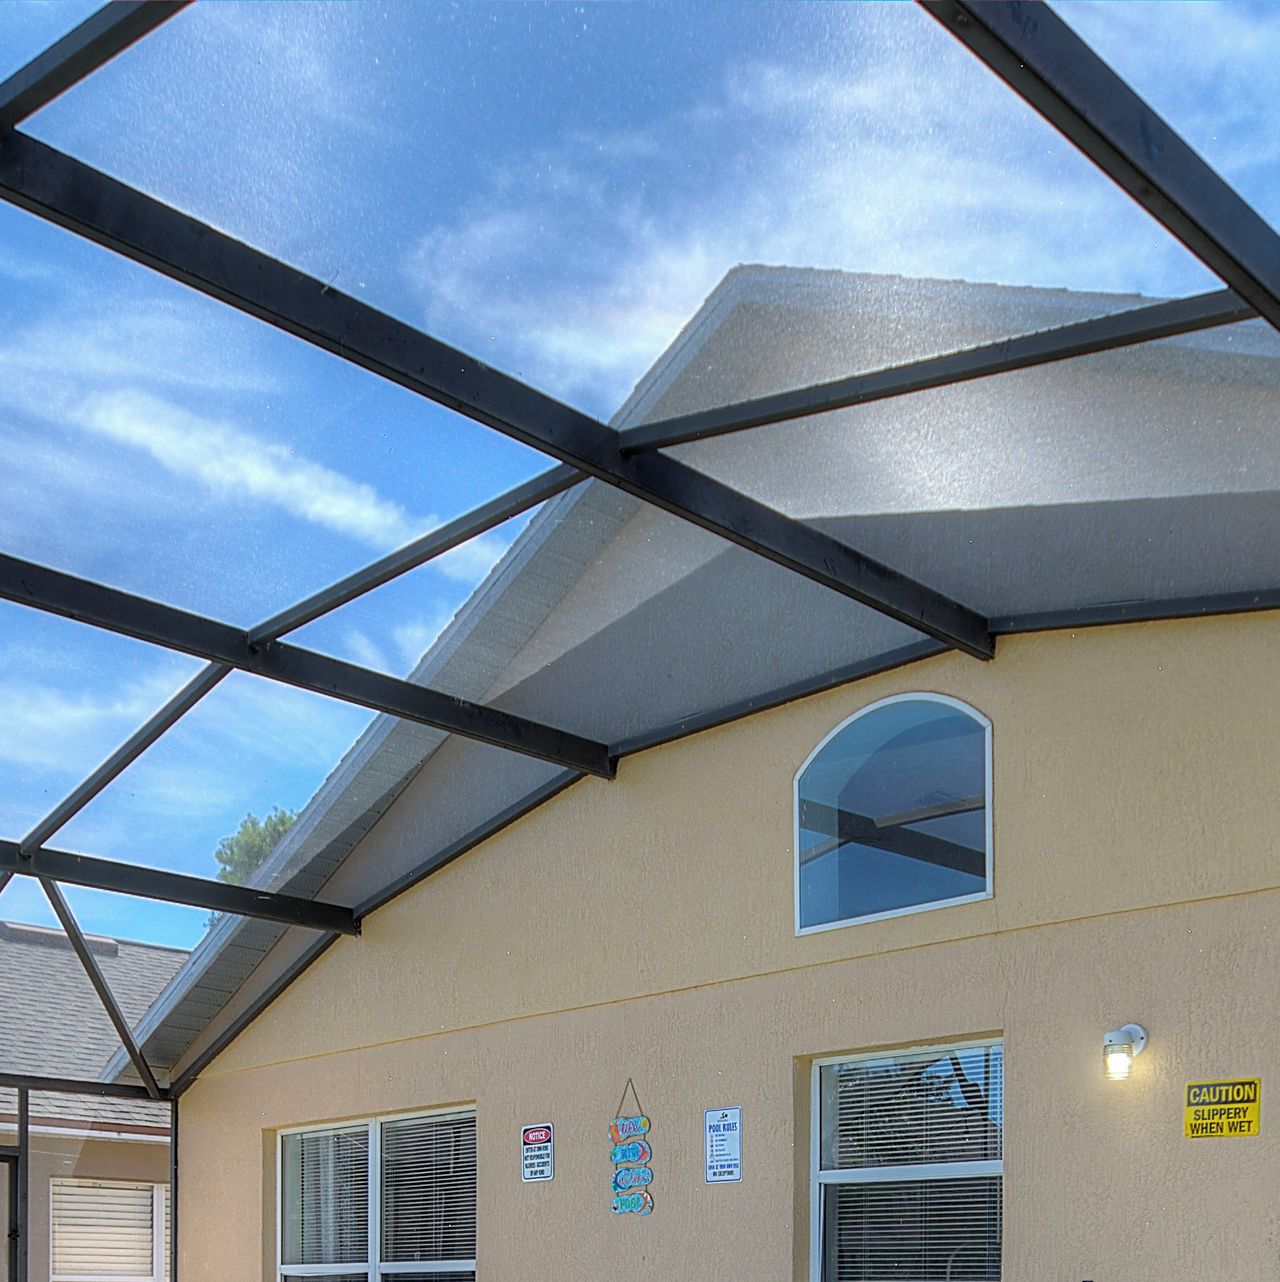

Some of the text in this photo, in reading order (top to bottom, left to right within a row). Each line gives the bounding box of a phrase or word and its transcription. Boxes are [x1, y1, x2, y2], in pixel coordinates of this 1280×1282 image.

[1190, 1085, 1255, 1104] CAUTION
[1194, 1107, 1249, 1121] SLIPPERY
[709, 1122, 737, 1133] POOL RULES
[1190, 1121, 1254, 1134] WHEN WET
[529, 1131, 546, 1141] NOTICE
